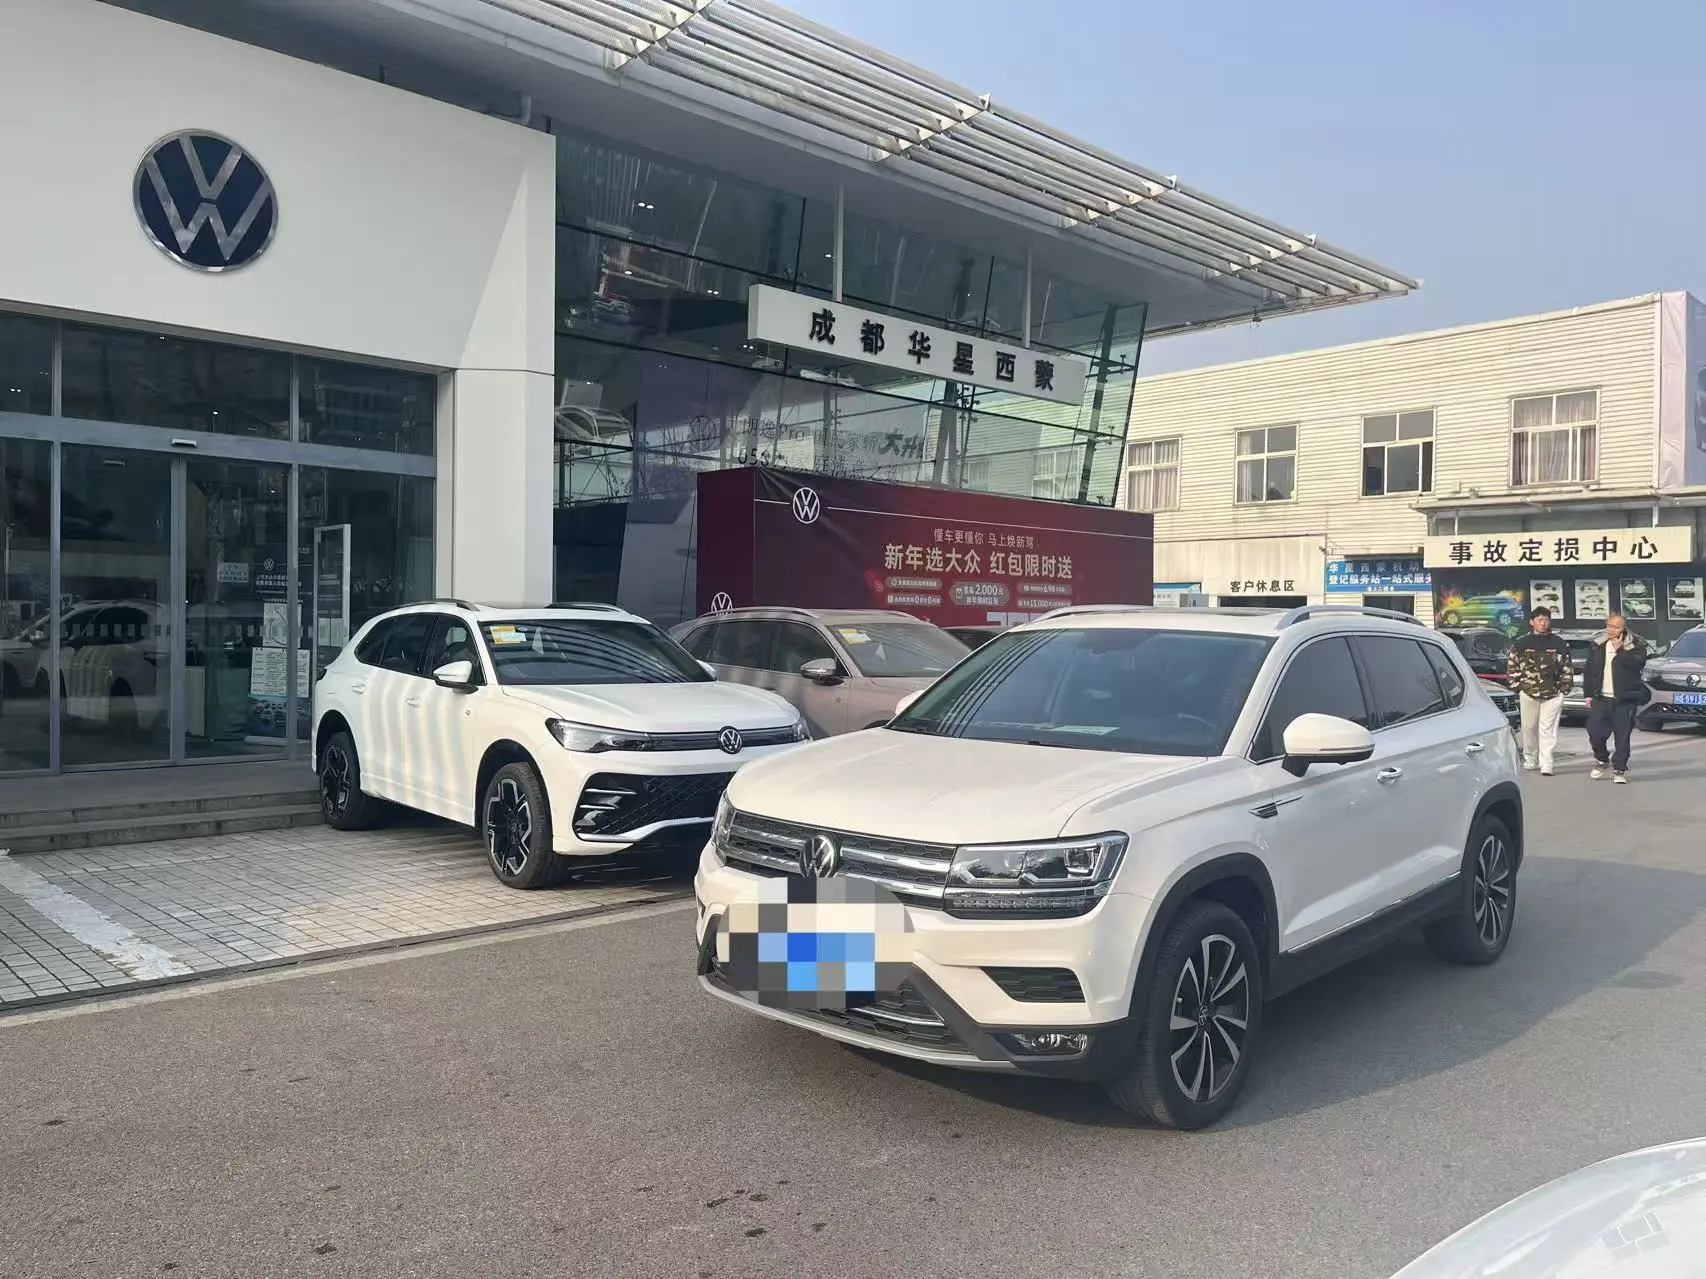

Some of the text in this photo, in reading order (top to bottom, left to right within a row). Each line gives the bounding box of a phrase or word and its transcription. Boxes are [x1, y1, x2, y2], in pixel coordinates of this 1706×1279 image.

[809, 308, 1054, 391] 成都华星西蒙
[933, 528, 1034, 549] 懂车更懂你 马上焕新驾
[1449, 535, 1658, 565] 事故定损中心
[885, 543, 1073, 579] 新年选大众 红包限时送
[1230, 580, 1295, 593] 客户休息区
